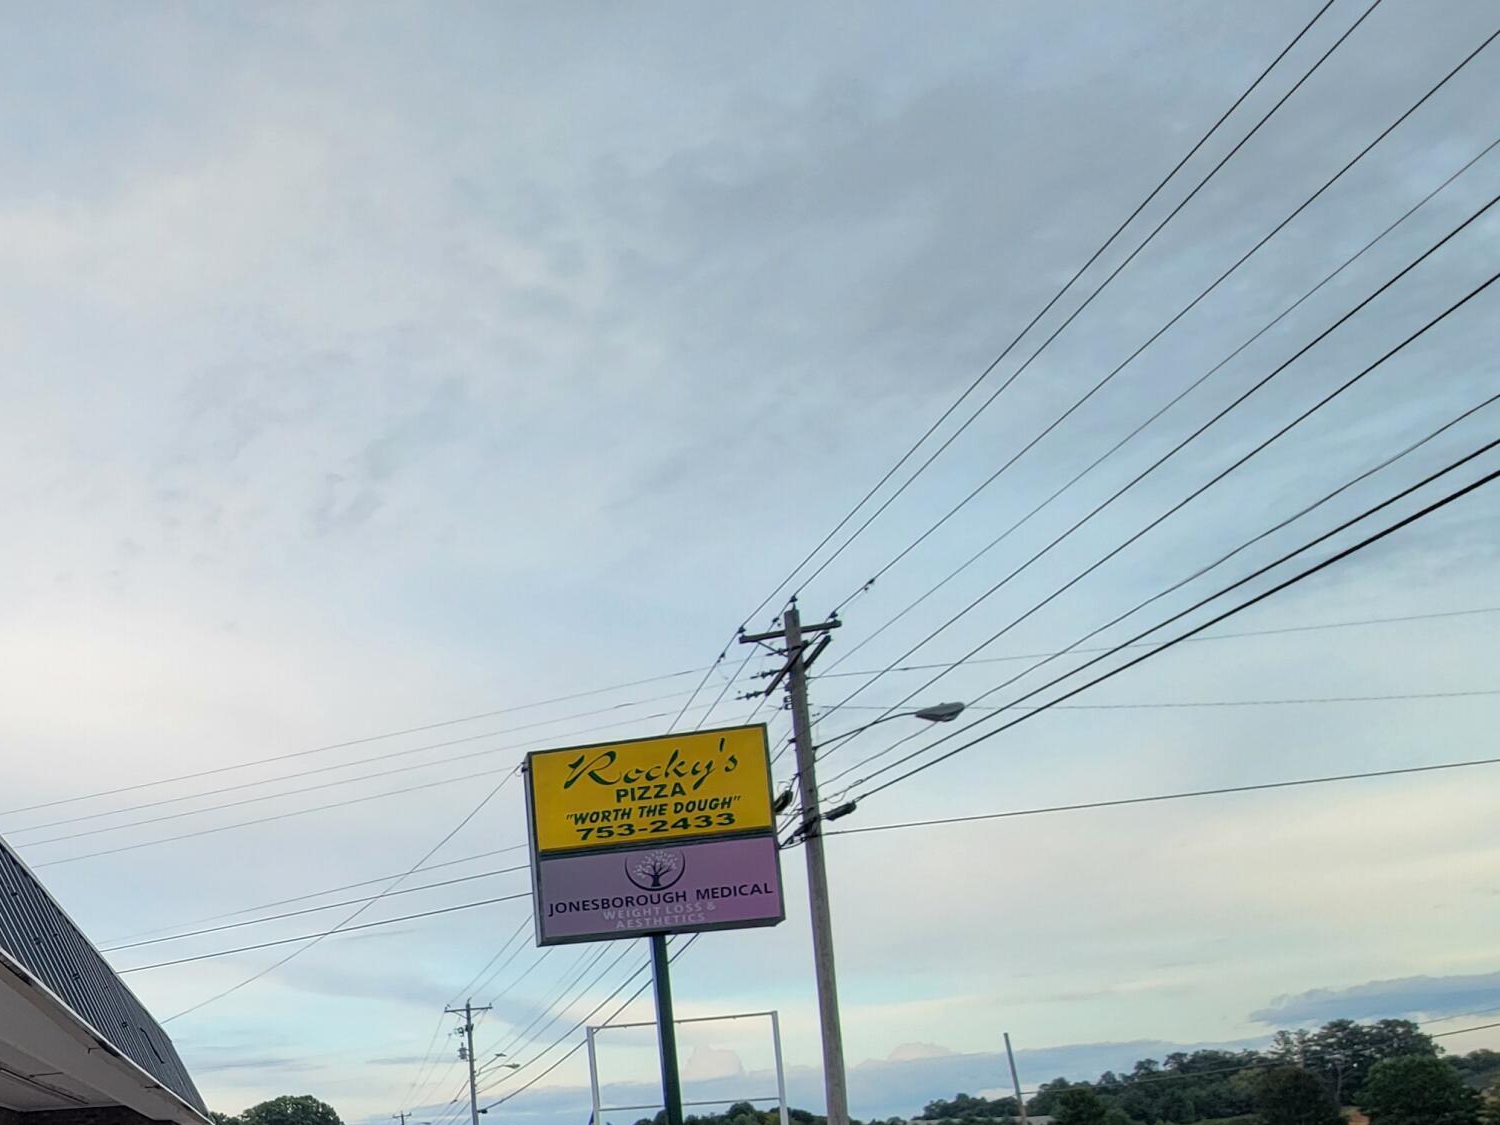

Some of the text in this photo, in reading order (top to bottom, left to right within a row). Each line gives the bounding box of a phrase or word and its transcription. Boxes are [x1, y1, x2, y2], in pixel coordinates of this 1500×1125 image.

[563, 737, 739, 790] Rocky's
[615, 782, 687, 803] PIZZA
[566, 795, 741, 826] "WORTH THE DOUGH"
[575, 812, 736, 841] 753-2433
[548, 882, 774, 917] JONESBOROUGH MEDICAL
[602, 901, 717, 921] WEIGHT LOSS &
[616, 912, 707, 930] AESTHETICS
